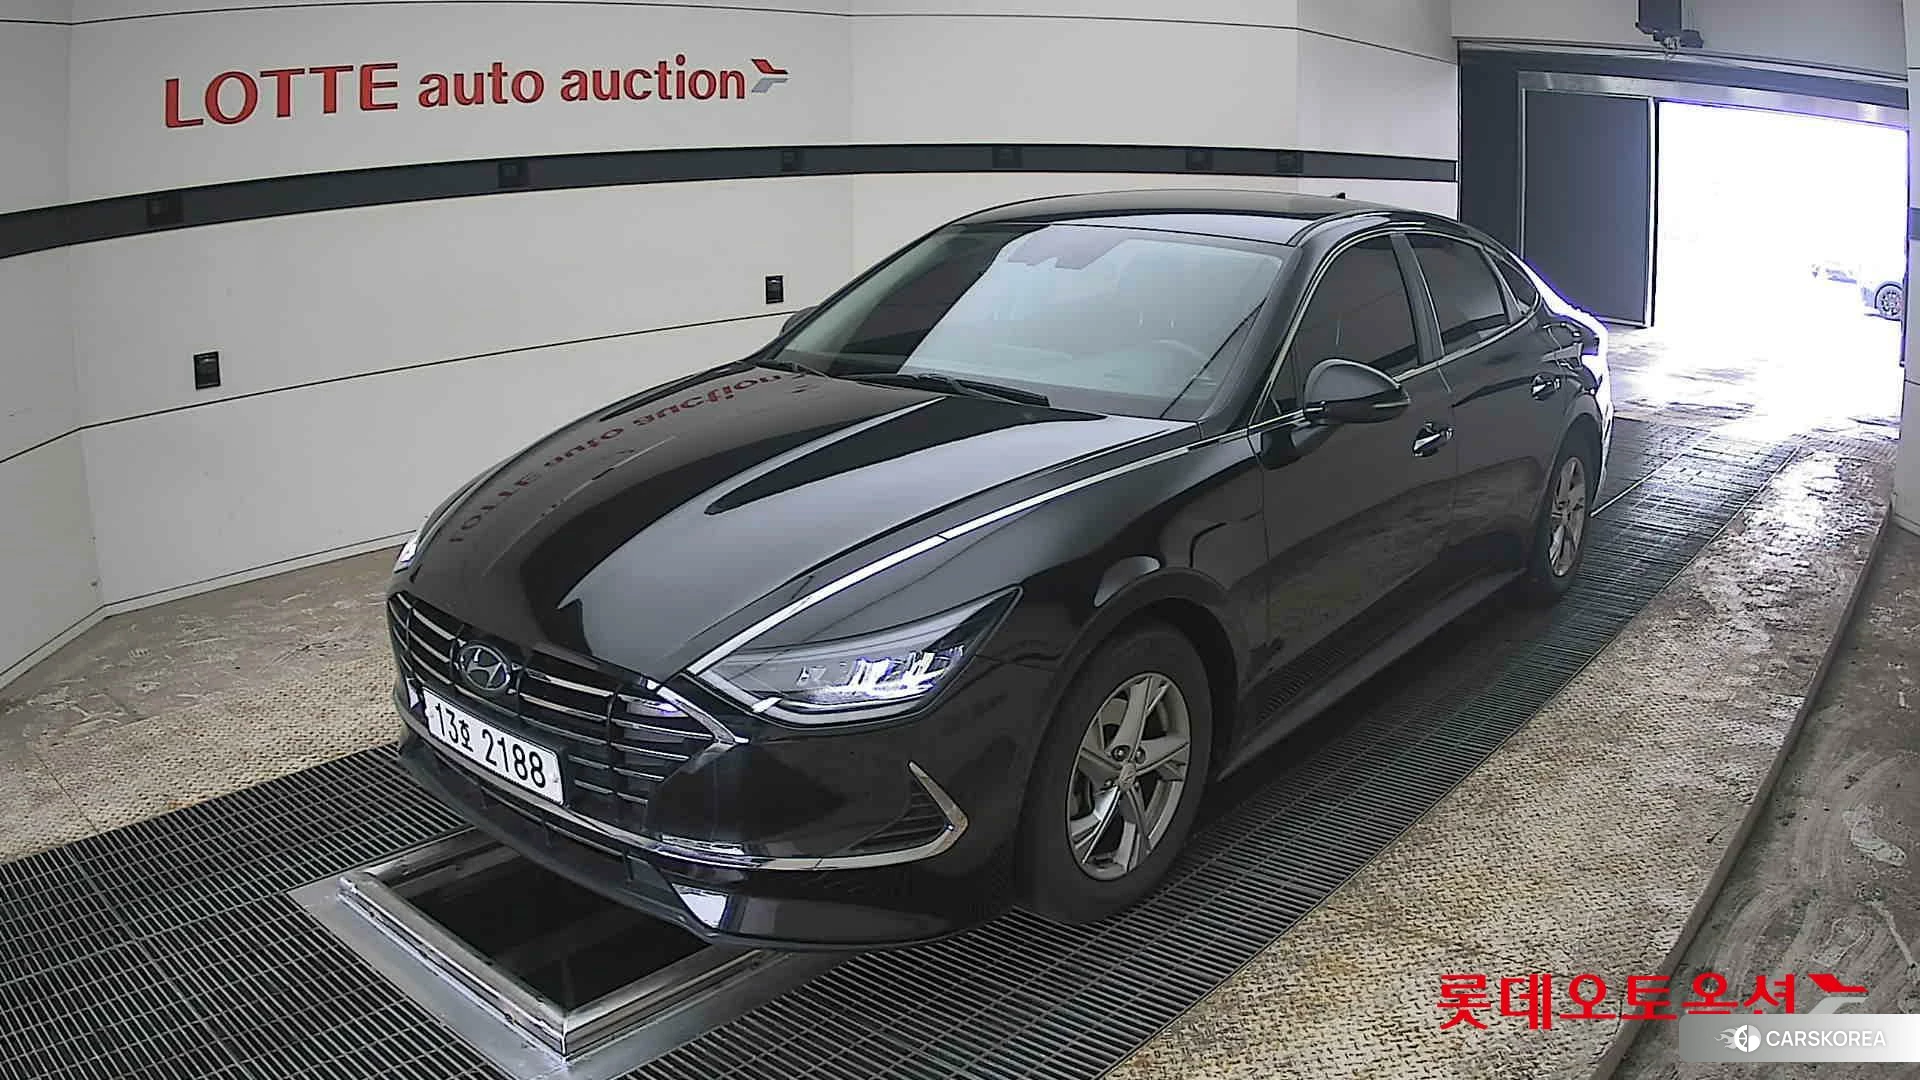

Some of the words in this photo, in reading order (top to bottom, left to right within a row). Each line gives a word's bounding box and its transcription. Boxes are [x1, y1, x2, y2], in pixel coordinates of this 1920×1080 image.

[164, 63, 399, 129] LOTTE
[418, 62, 545, 108] auto
[560, 54, 746, 102] auction
[434, 702, 474, 753] 13호
[481, 727, 547, 789] 2188
